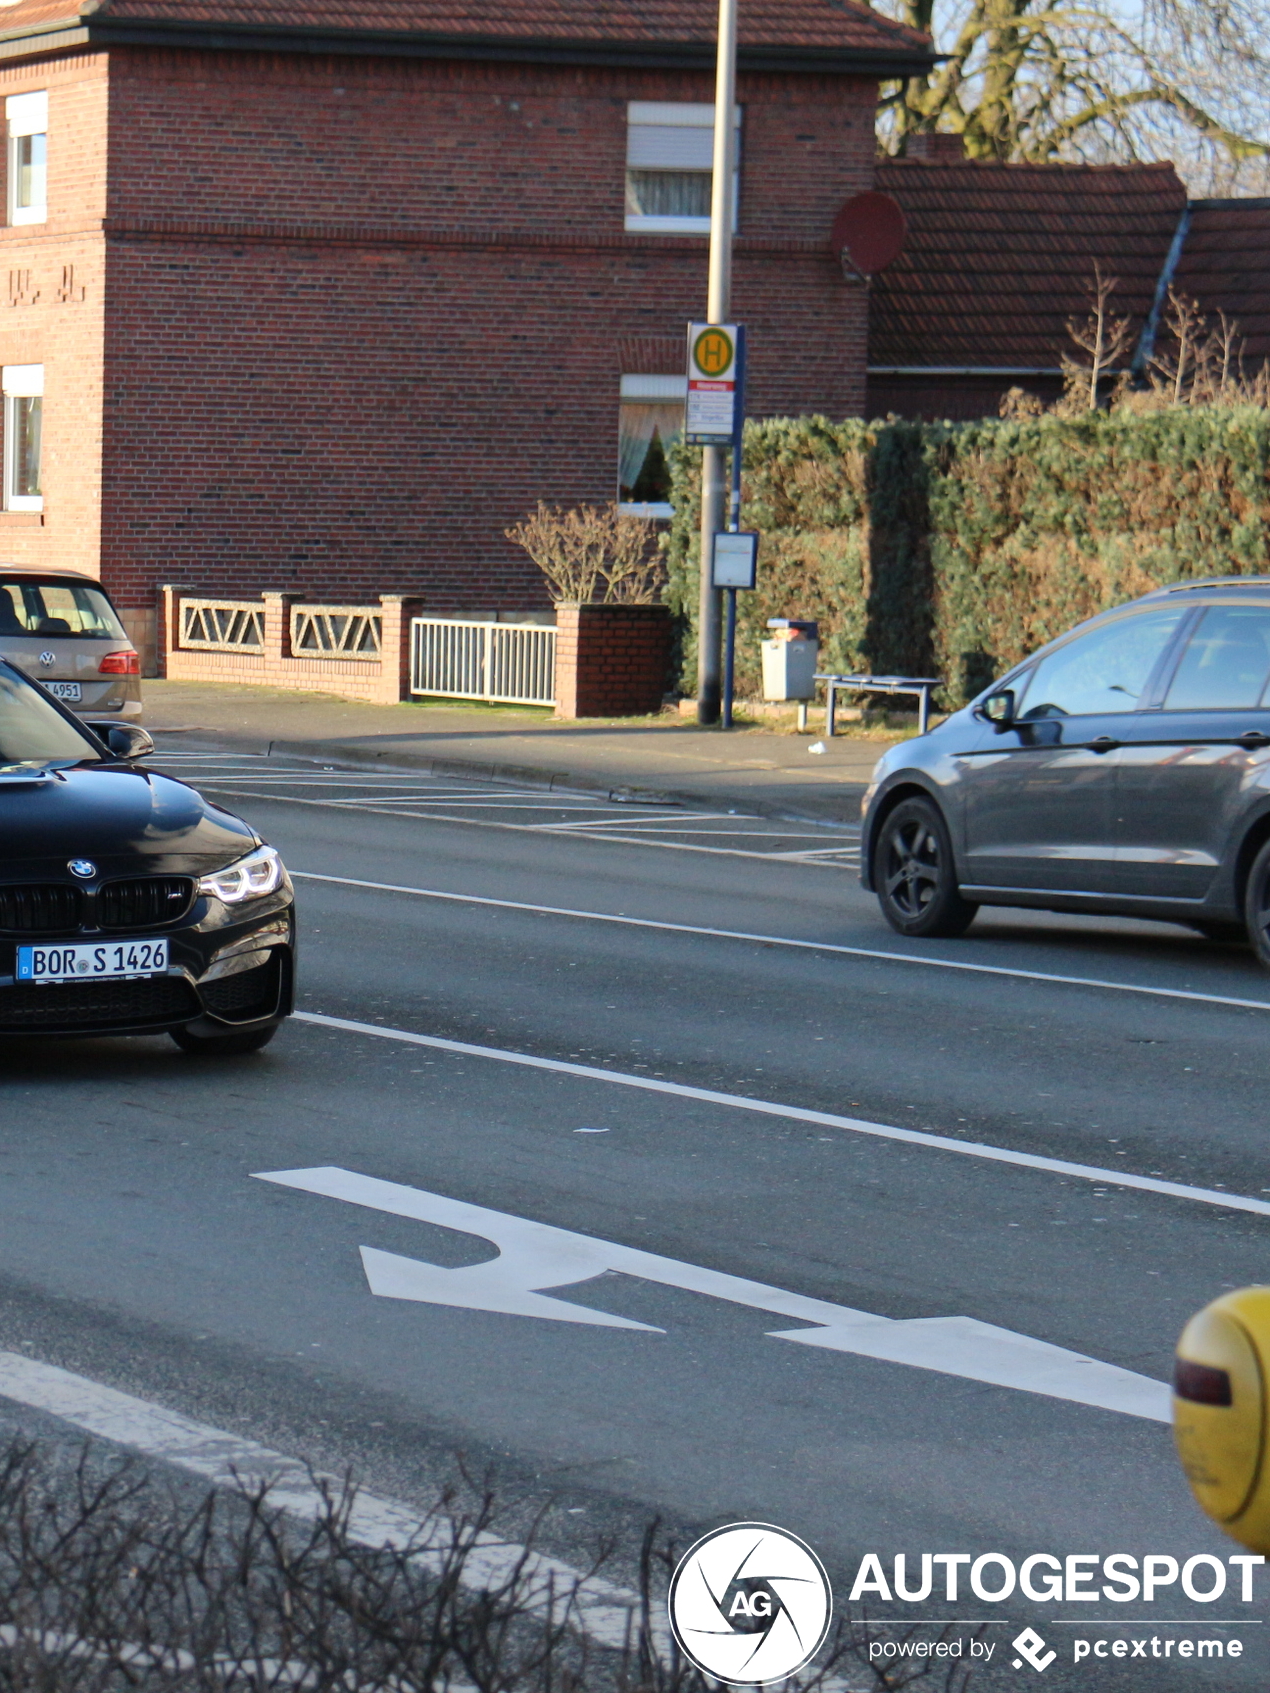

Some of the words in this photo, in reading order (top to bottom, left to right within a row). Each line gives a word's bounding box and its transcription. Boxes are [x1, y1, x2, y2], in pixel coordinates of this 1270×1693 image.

[704, 339, 722, 367] H
[53, 684, 79, 697] 4951
[33, 949, 76, 975] BOR
[93, 947, 106, 973] S
[113, 943, 165, 971] 1426
[22, 966, 29, 975] D
